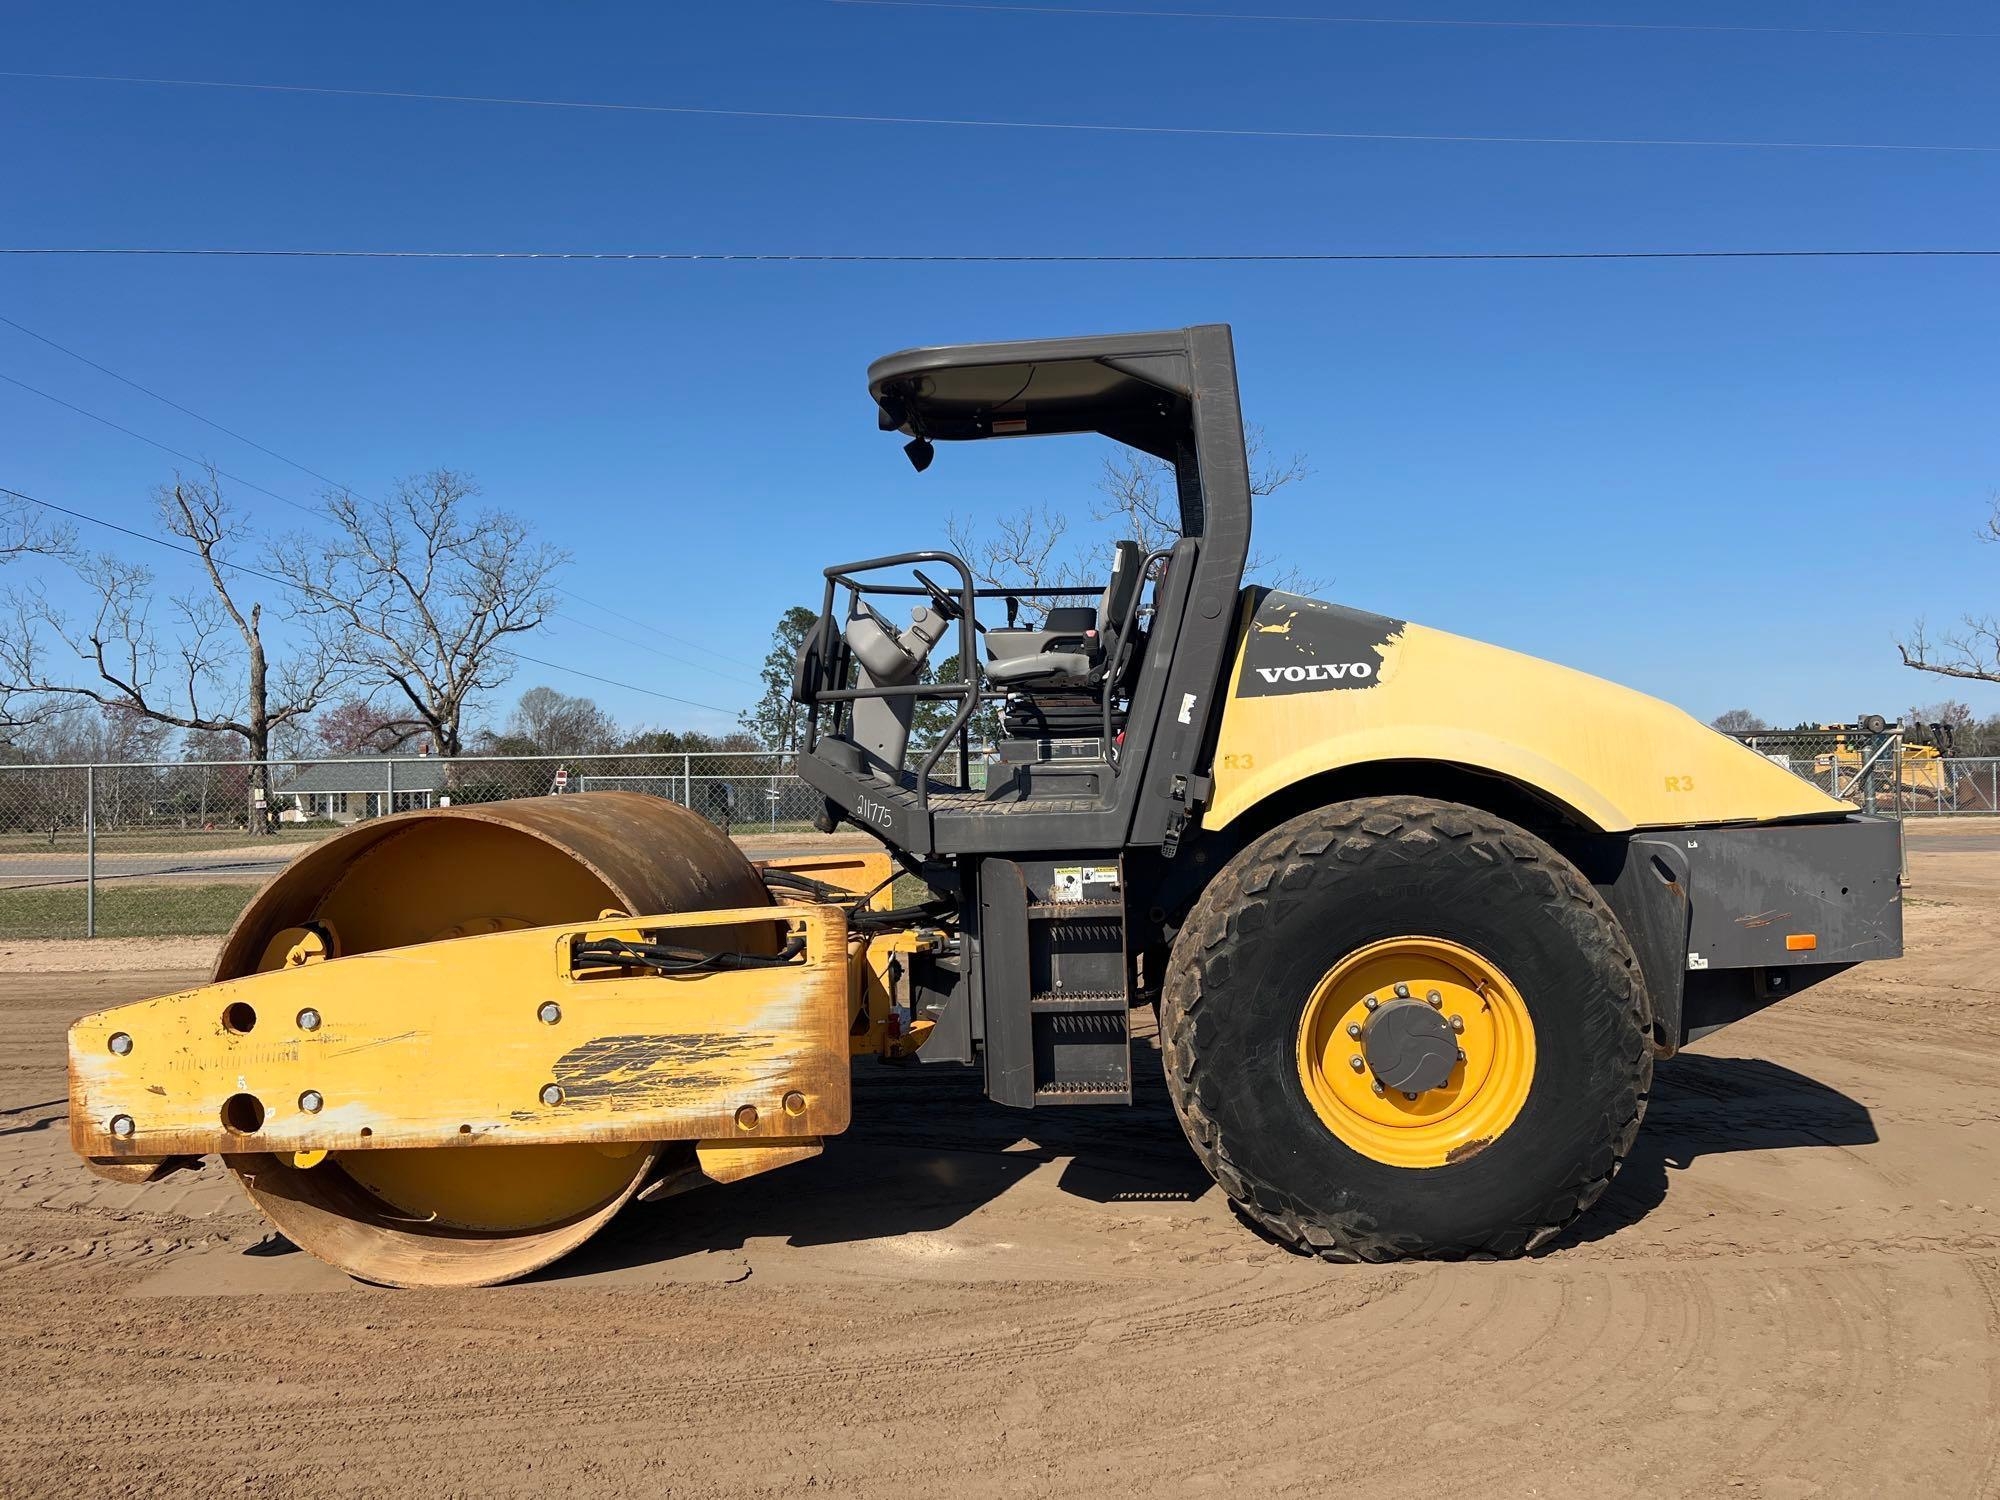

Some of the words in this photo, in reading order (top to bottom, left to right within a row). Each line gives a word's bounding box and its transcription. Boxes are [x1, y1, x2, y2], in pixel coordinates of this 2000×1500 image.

[1256, 662, 1372, 684] VOLVO
[1224, 754, 1254, 770] R3
[1664, 775, 1695, 792] R3
[857, 794, 892, 828] 211775
